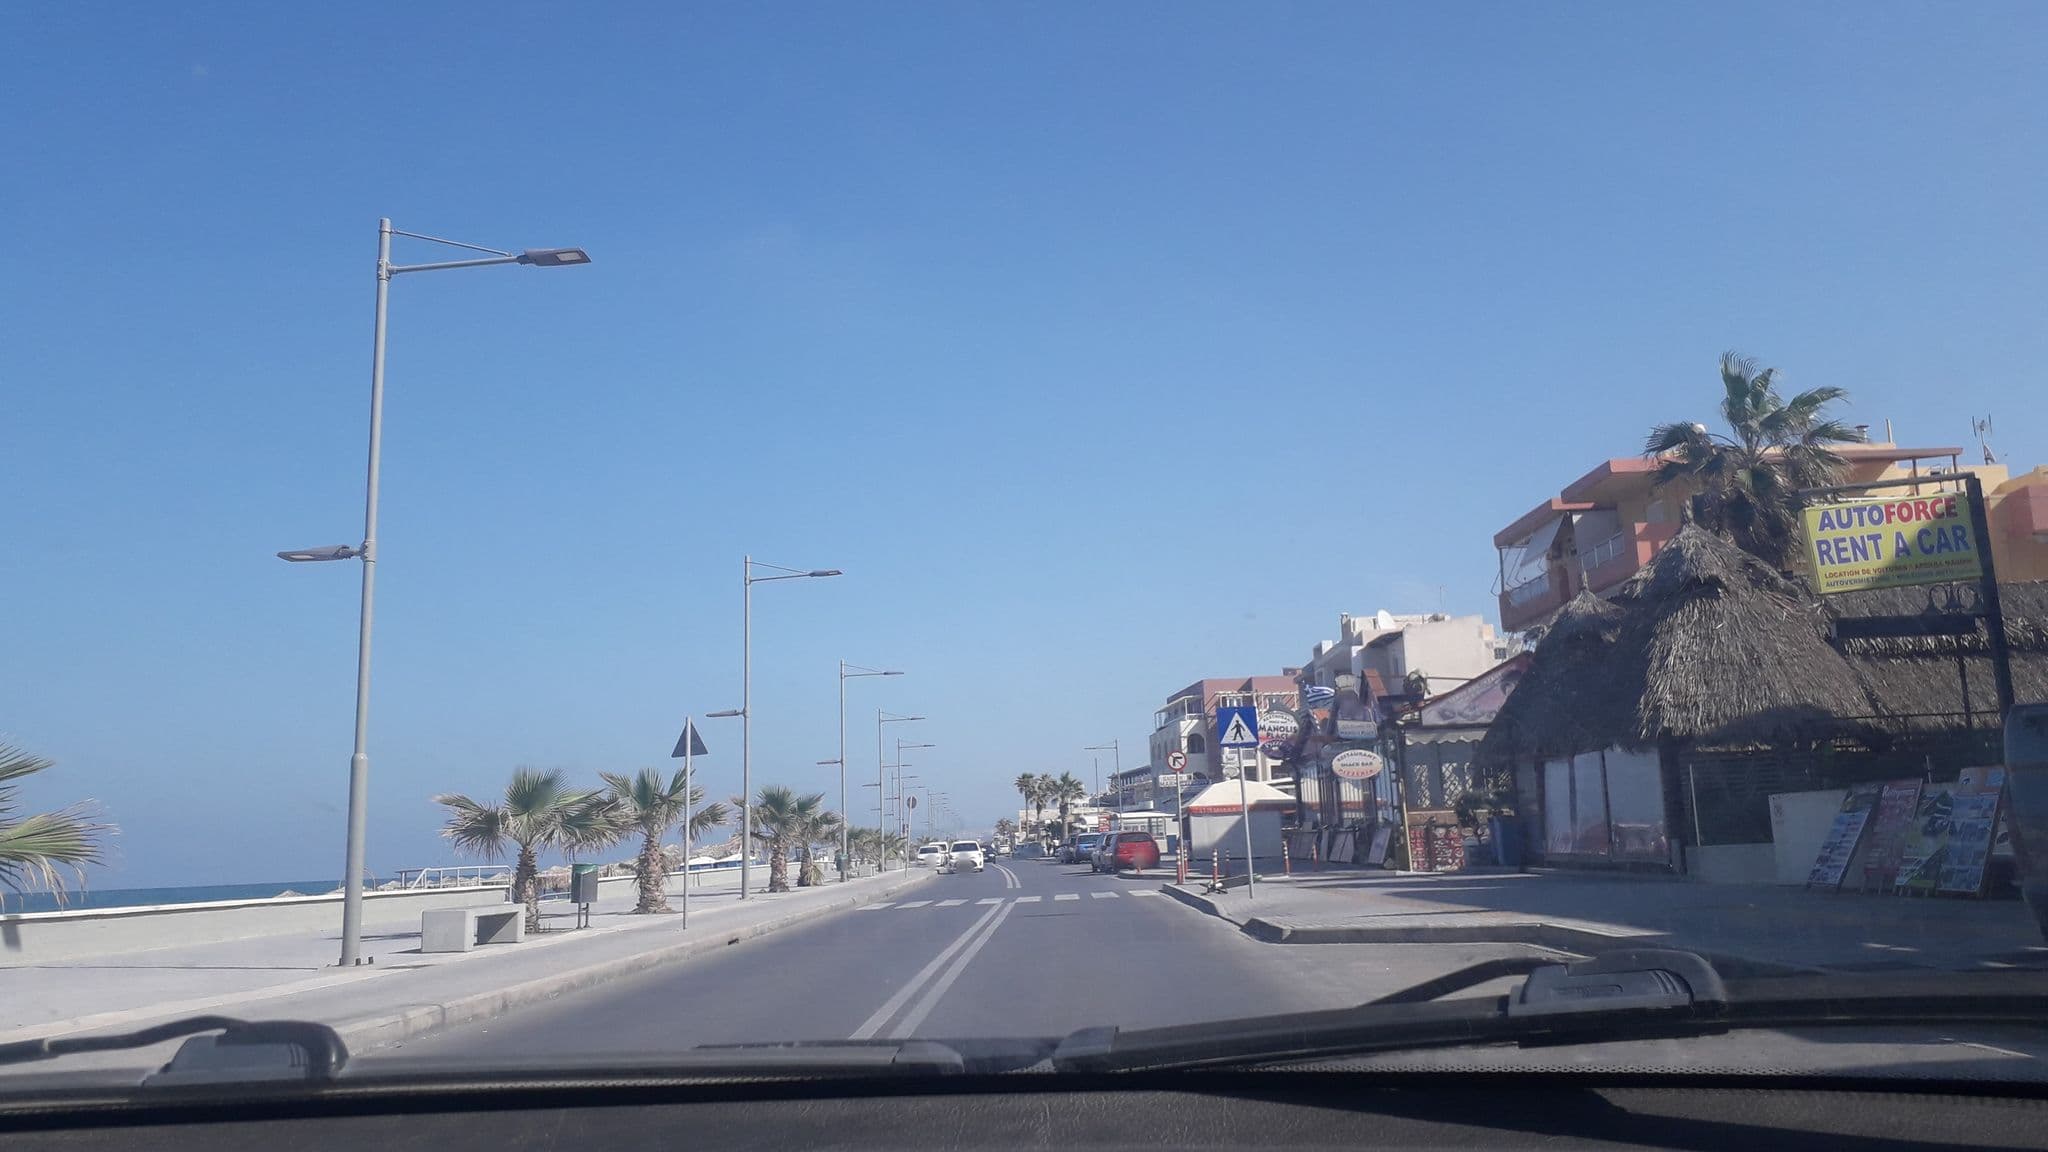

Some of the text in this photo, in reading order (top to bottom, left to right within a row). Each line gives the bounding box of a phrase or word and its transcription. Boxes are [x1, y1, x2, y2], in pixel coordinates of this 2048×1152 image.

[1818, 496, 1958, 532] AUTOFORCE
[1815, 532, 1882, 566] RENT
[1894, 531, 1911, 560] A
[1917, 524, 1970, 556] CAR
[1824, 569, 1860, 579] LOCATION
[1259, 724, 1298, 733] MANOLIS
[1337, 751, 1376, 762] RESTAURANT
